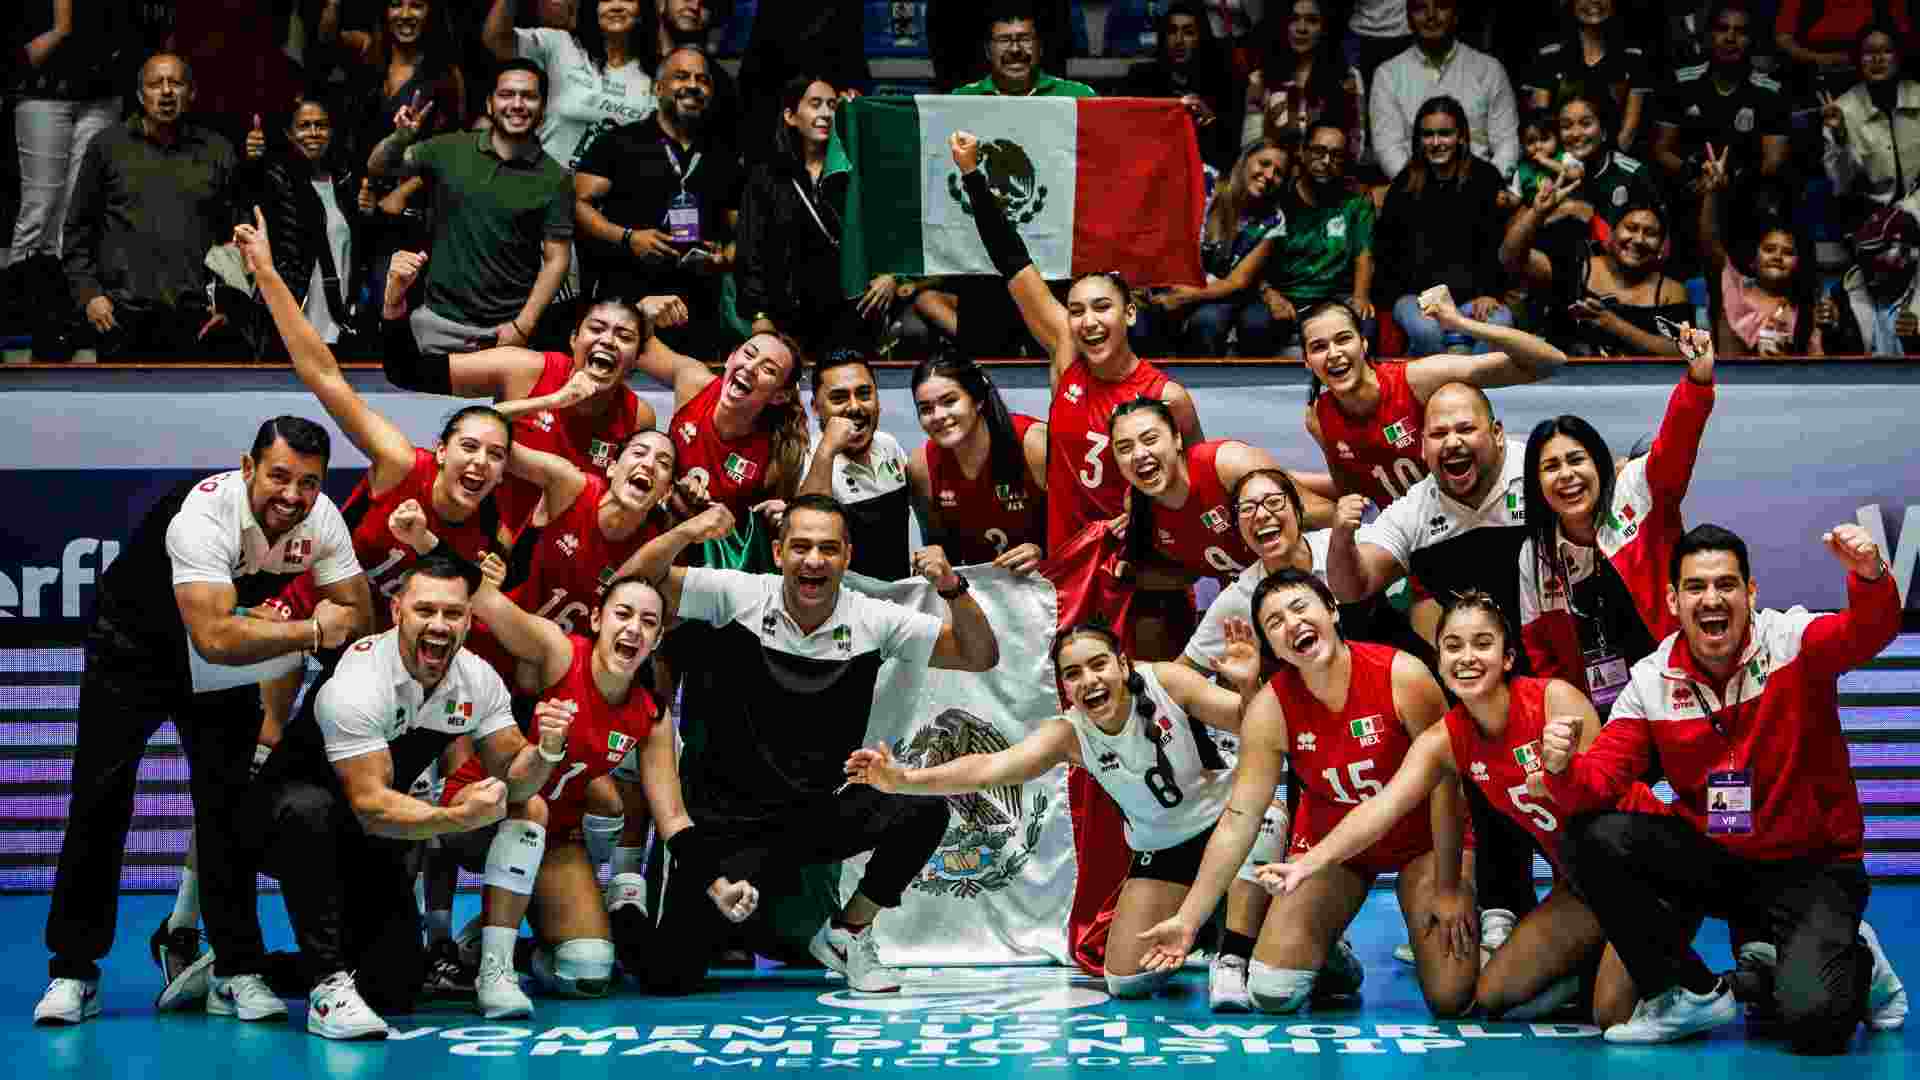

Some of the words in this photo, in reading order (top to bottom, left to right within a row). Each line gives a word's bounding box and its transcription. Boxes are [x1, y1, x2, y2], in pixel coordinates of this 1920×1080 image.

[1080, 430, 1109, 488] 3
[1360, 734, 1381, 748] MEX
[1322, 759, 1377, 804] 15
[1507, 783, 1558, 831] 5
[1167, 1024, 1604, 1039] WORLD
[449, 1039, 1467, 1056] CHAMPIONSHIP
[692, 1056, 1001, 1068] MEXICO
